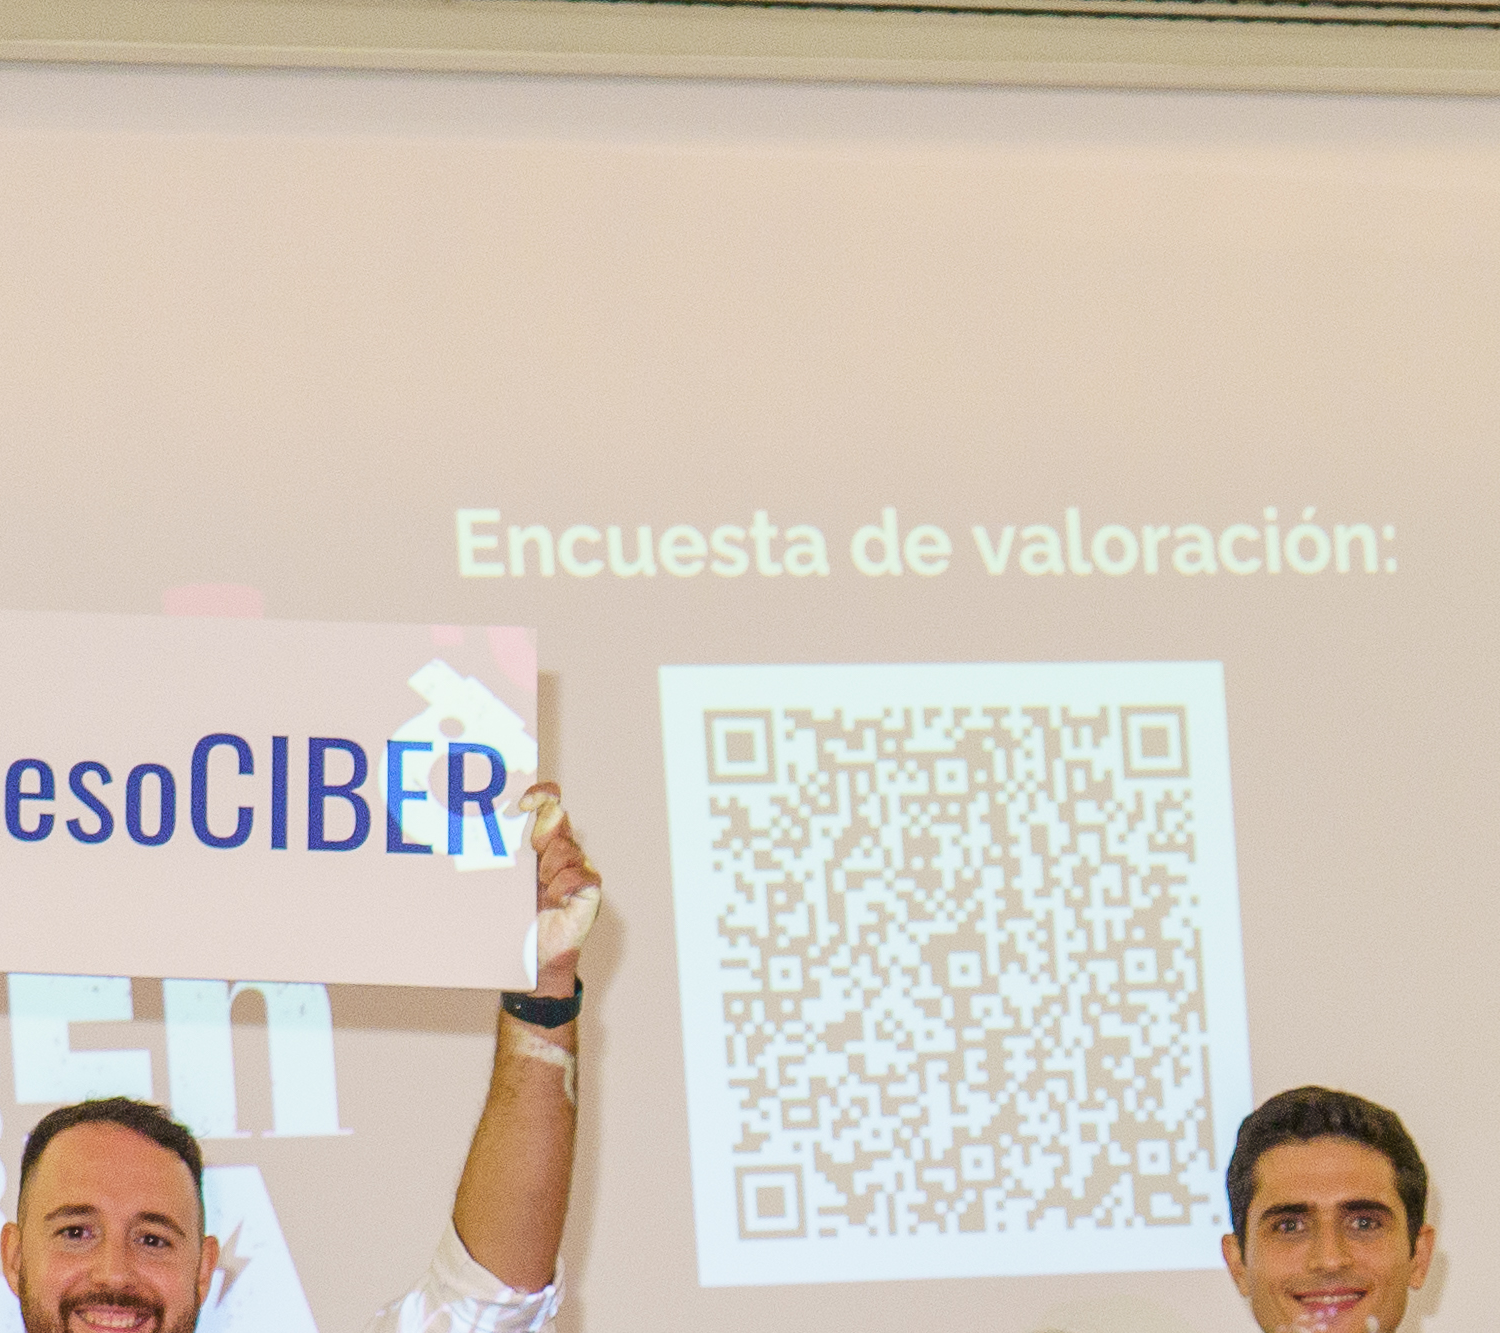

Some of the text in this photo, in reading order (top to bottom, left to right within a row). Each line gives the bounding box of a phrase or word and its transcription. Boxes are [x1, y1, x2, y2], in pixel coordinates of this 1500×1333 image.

[454, 505, 1398, 577] Encuesta de valoración:
